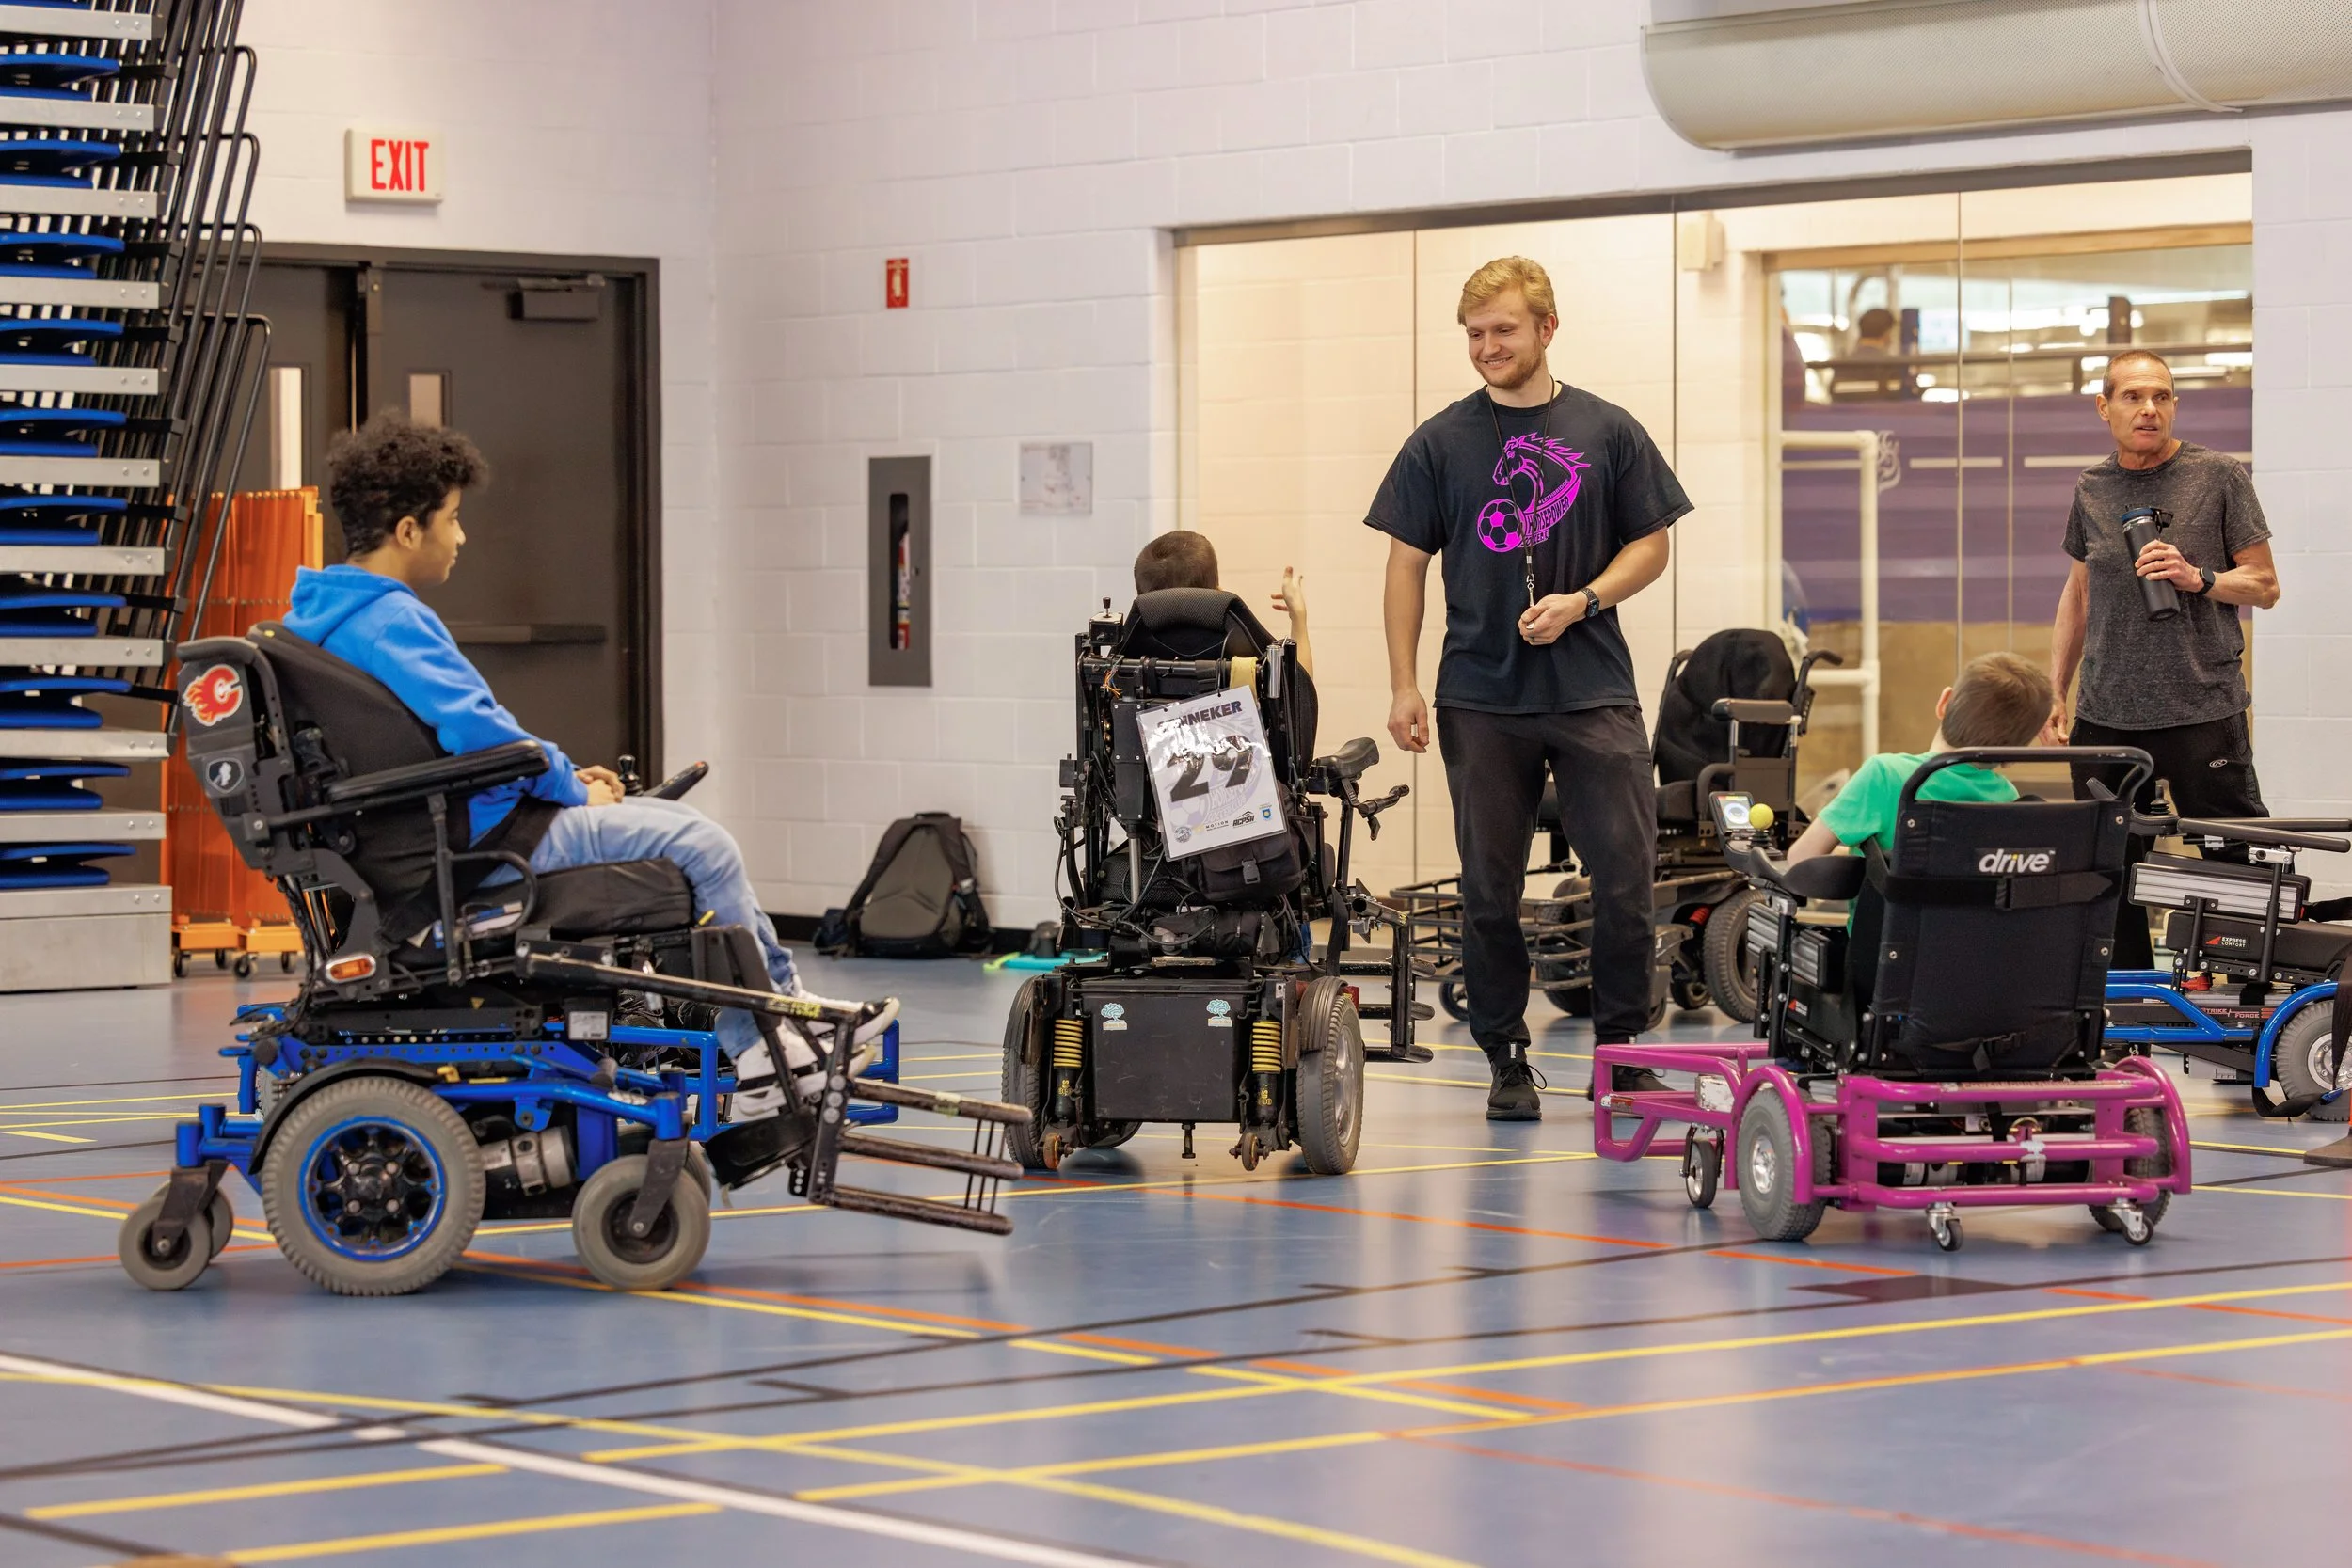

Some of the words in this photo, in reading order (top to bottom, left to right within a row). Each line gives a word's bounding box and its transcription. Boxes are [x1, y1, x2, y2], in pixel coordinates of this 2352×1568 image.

[371, 139, 430, 192] EXIT
[1157, 701, 1242, 730] NNEKER
[1167, 736, 1253, 802] 29
[1205, 820, 1229, 829] MOTION
[1979, 848, 2050, 873] drive
[2221, 936, 2247, 944] EXPRESS
